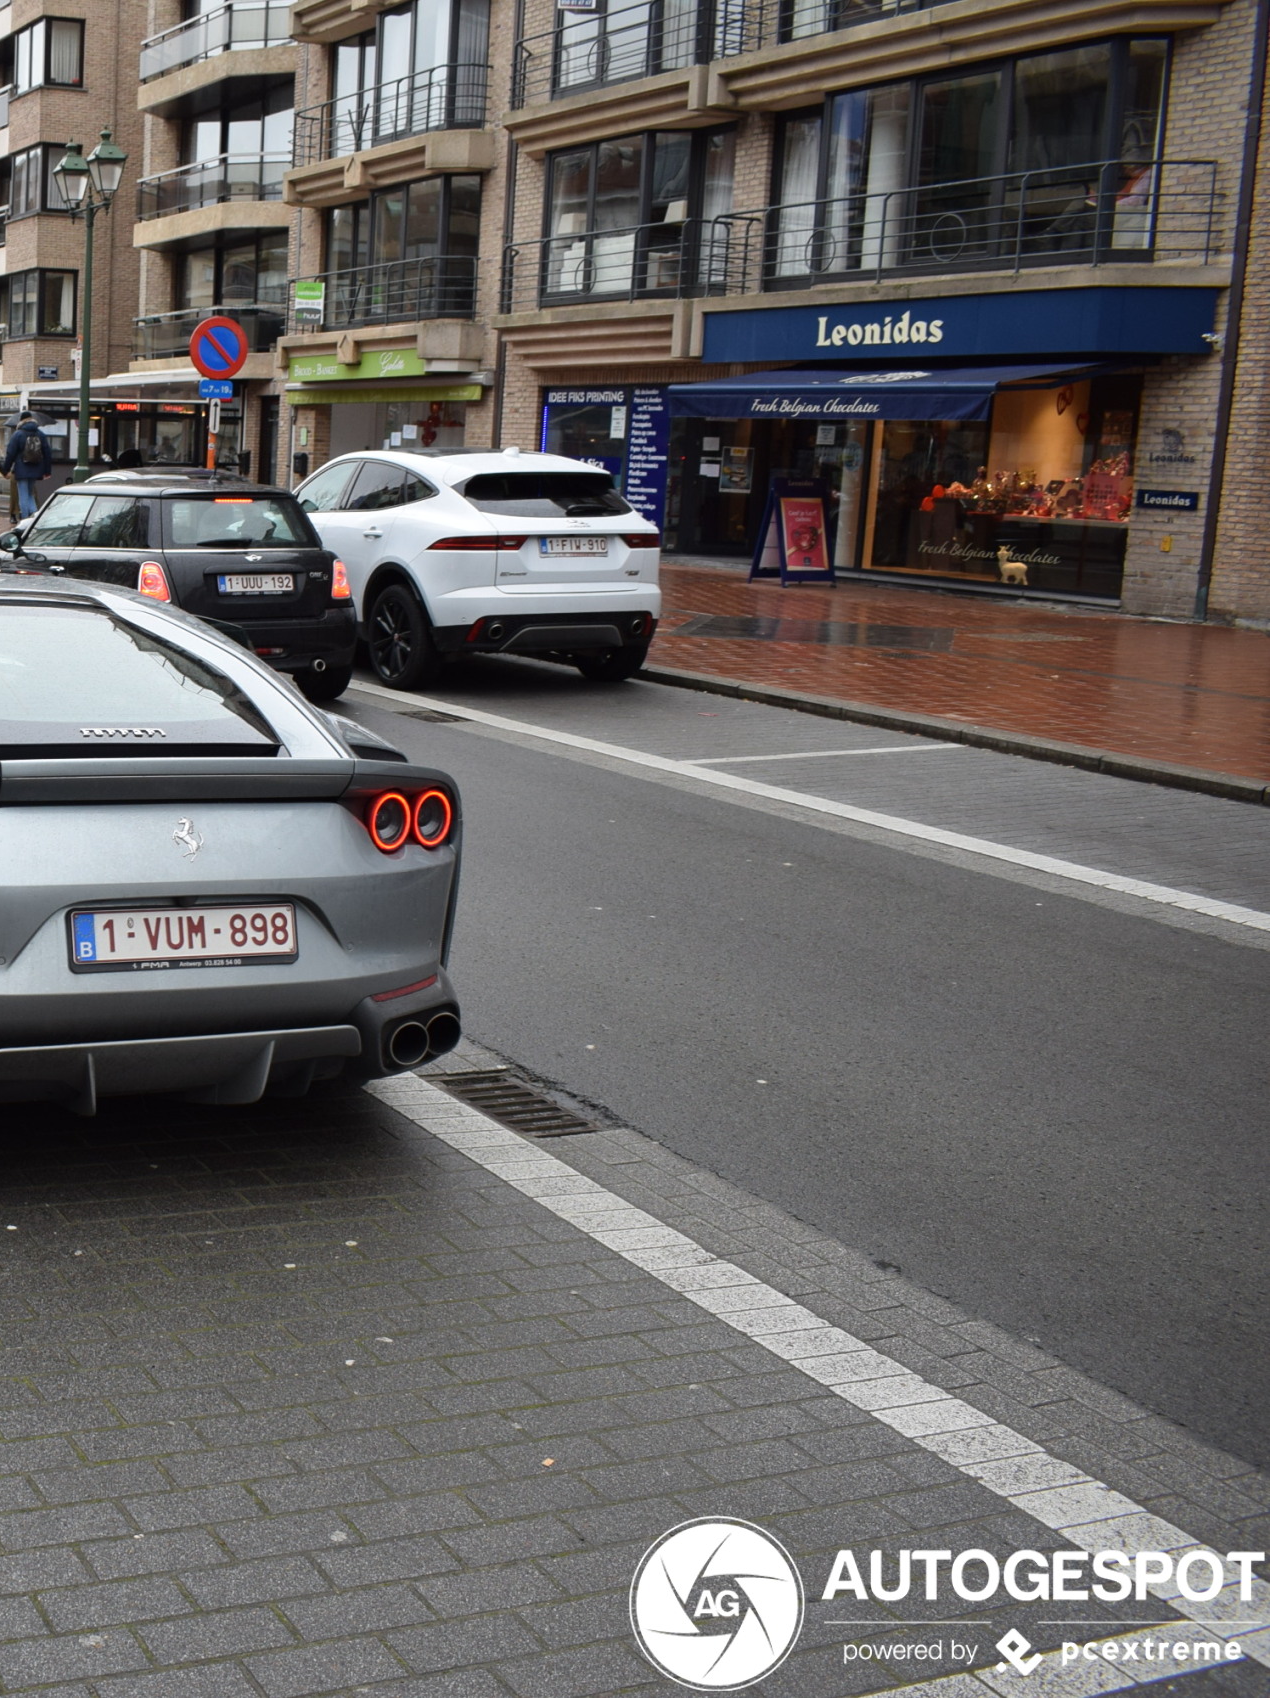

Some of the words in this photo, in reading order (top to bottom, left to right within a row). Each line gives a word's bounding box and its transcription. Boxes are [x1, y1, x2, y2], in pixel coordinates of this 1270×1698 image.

[815, 310, 944, 346] Leonidas
[209, 385, 215, 393] 7
[548, 391, 567, 403] IDEE
[568, 391, 585, 403] FIKS
[586, 390, 625, 403] PRINTING
[750, 398, 777, 412] Fresh
[779, 397, 821, 417] Belgian
[823, 397, 880, 413] Chocolates
[1148, 451, 1195, 463] Leonidas
[1143, 493, 1191, 507] Leonidas
[918, 540, 948, 555] Fresh
[949, 543, 994, 562] Belgian
[1003, 544, 1062, 565] hocolates
[228, 576, 292, 589] 1-UUU-192
[80, 727, 166, 737] Ferrari
[80, 942, 93, 958] B
[103, 912, 289, 953] 1-VUM-898
[179, 960, 202, 969] Antwerp
